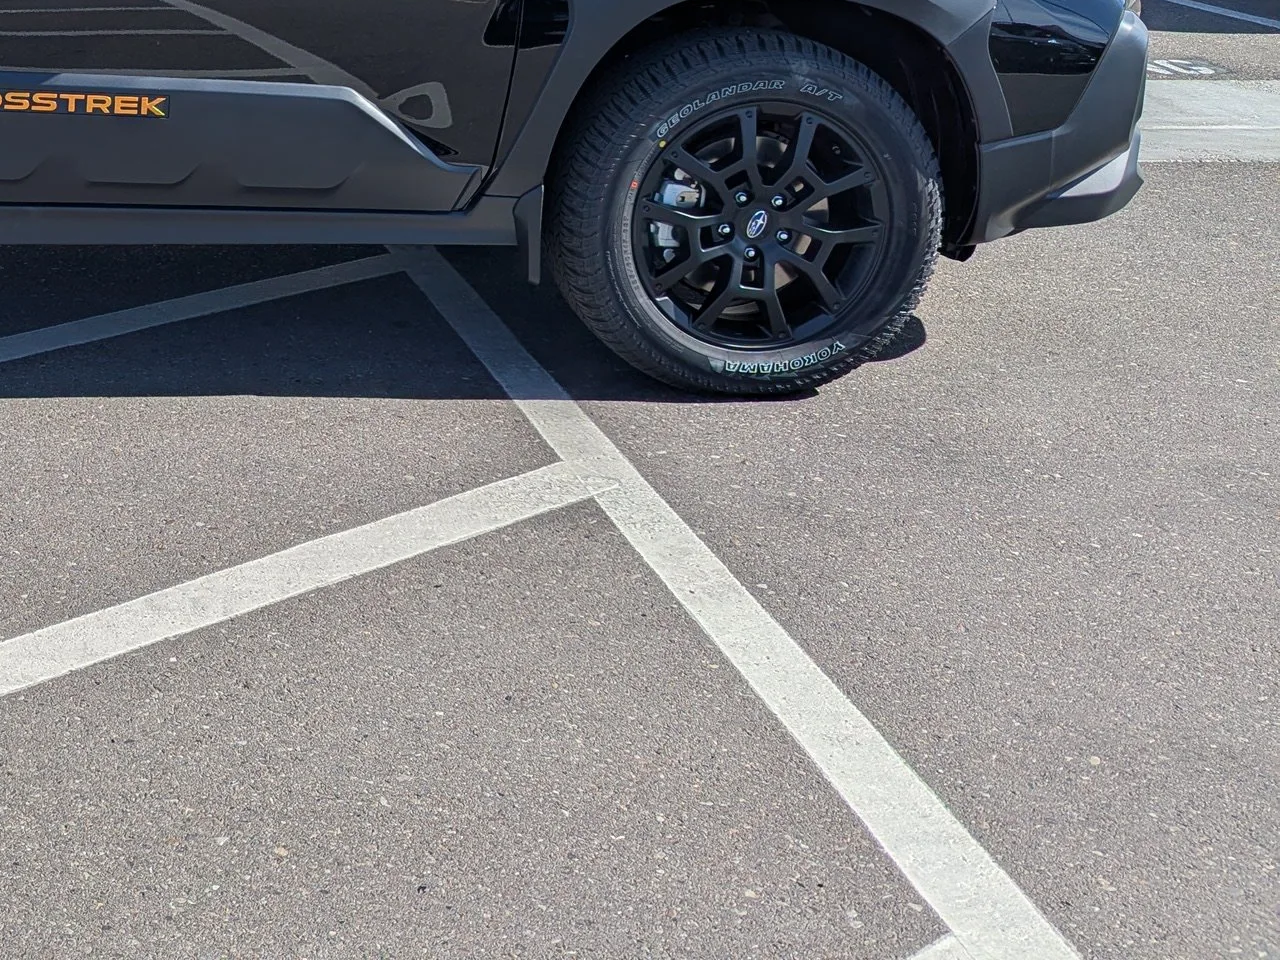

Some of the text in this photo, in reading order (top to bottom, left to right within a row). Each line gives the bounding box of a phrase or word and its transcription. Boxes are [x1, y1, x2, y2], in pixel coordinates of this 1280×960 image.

[656, 80, 843, 138] GEOLANDAR A/T
[725, 341, 846, 374] YOKOHAMA
